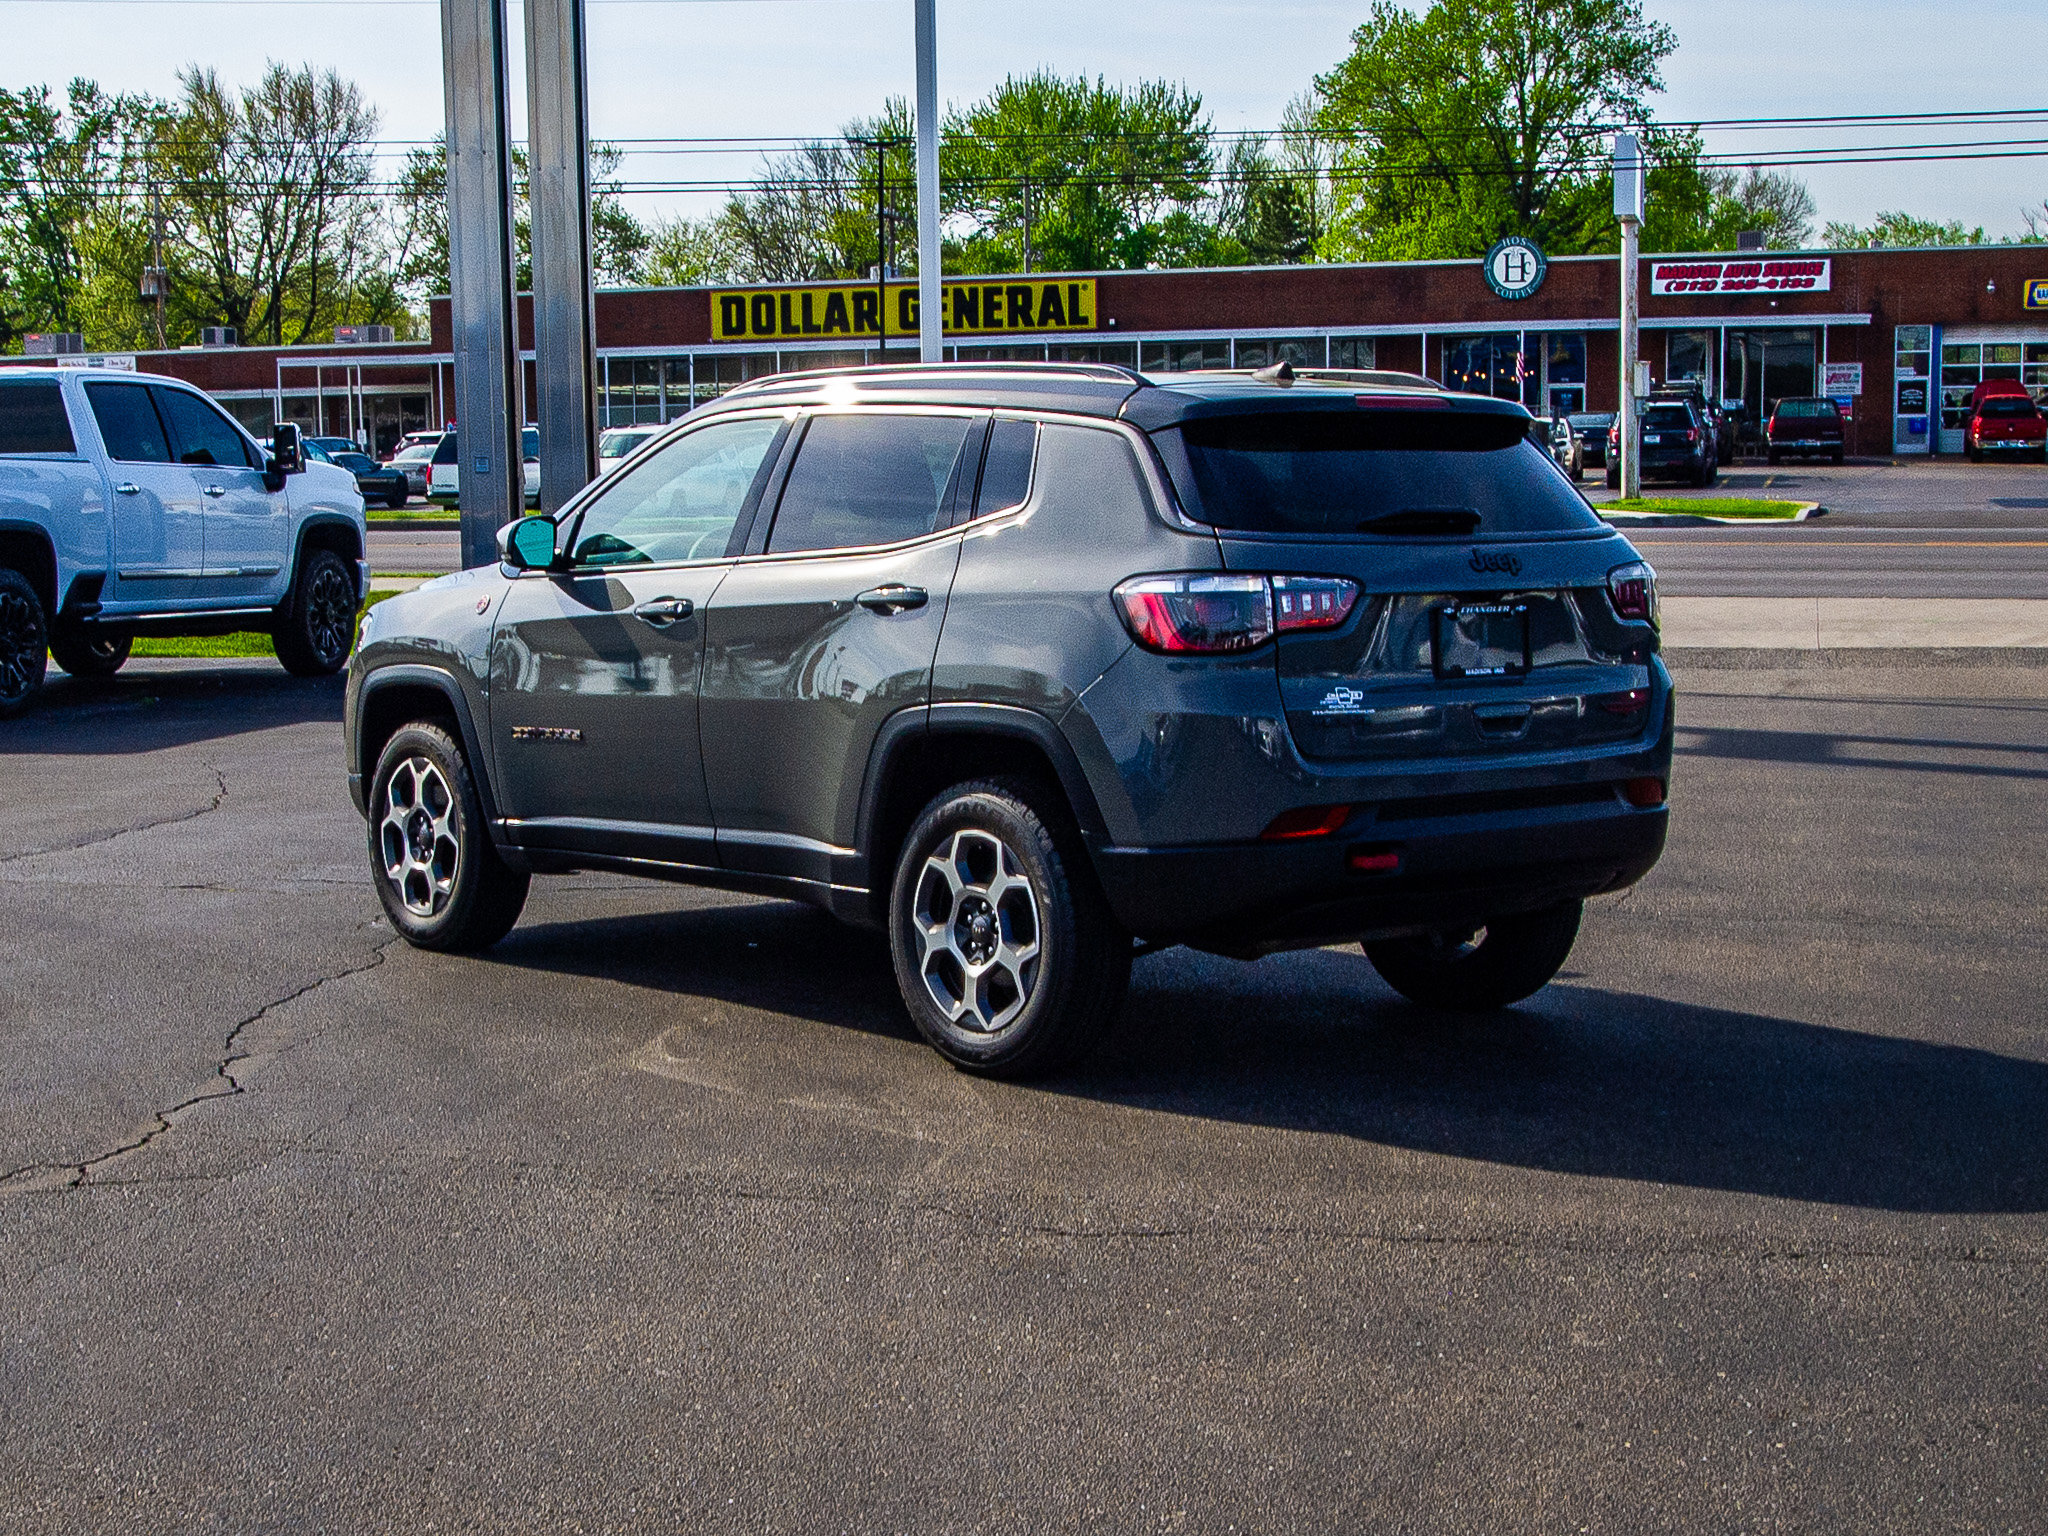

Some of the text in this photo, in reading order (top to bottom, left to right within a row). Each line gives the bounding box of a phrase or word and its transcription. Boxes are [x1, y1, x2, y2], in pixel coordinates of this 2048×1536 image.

[1655, 261, 1826, 280] MADISON AUTO SERVICE
[1495, 285, 1535, 300] COFFEE
[719, 290, 880, 336] DOLLAR
[1469, 548, 1522, 577] Jeep
